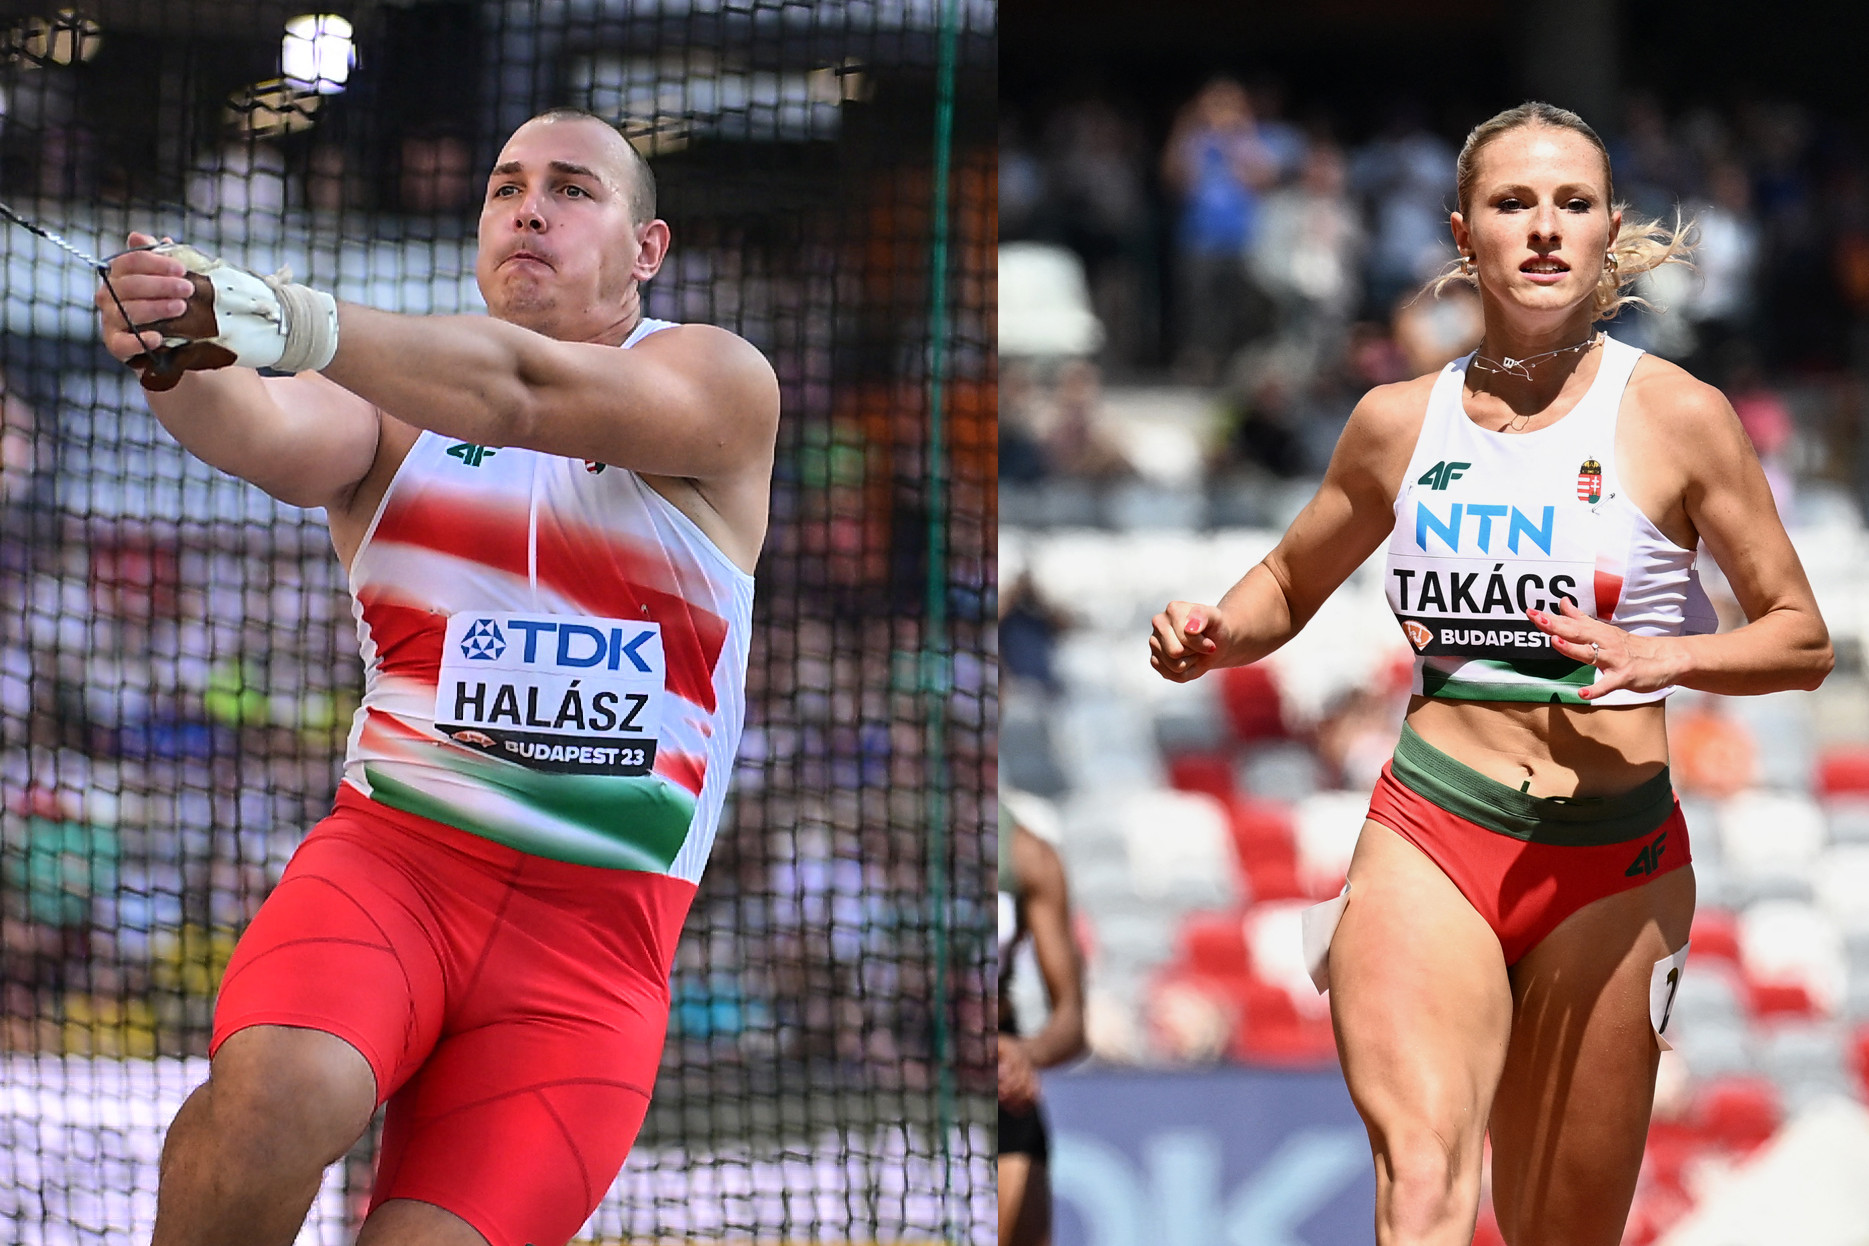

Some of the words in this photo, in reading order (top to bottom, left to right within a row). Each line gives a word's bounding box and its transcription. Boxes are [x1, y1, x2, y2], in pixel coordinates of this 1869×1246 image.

[1417, 460, 1472, 491] 4F
[1416, 500, 1555, 557] NTN
[1393, 563, 1578, 616] TAKÁCS
[508, 620, 656, 673] TDK
[1440, 629, 1553, 648] BUDAPEST
[454, 680, 649, 732] HALÁSZ
[504, 741, 620, 765] BUDAPEST
[621, 748, 645, 766] 23
[1624, 832, 1668, 877] 4F
